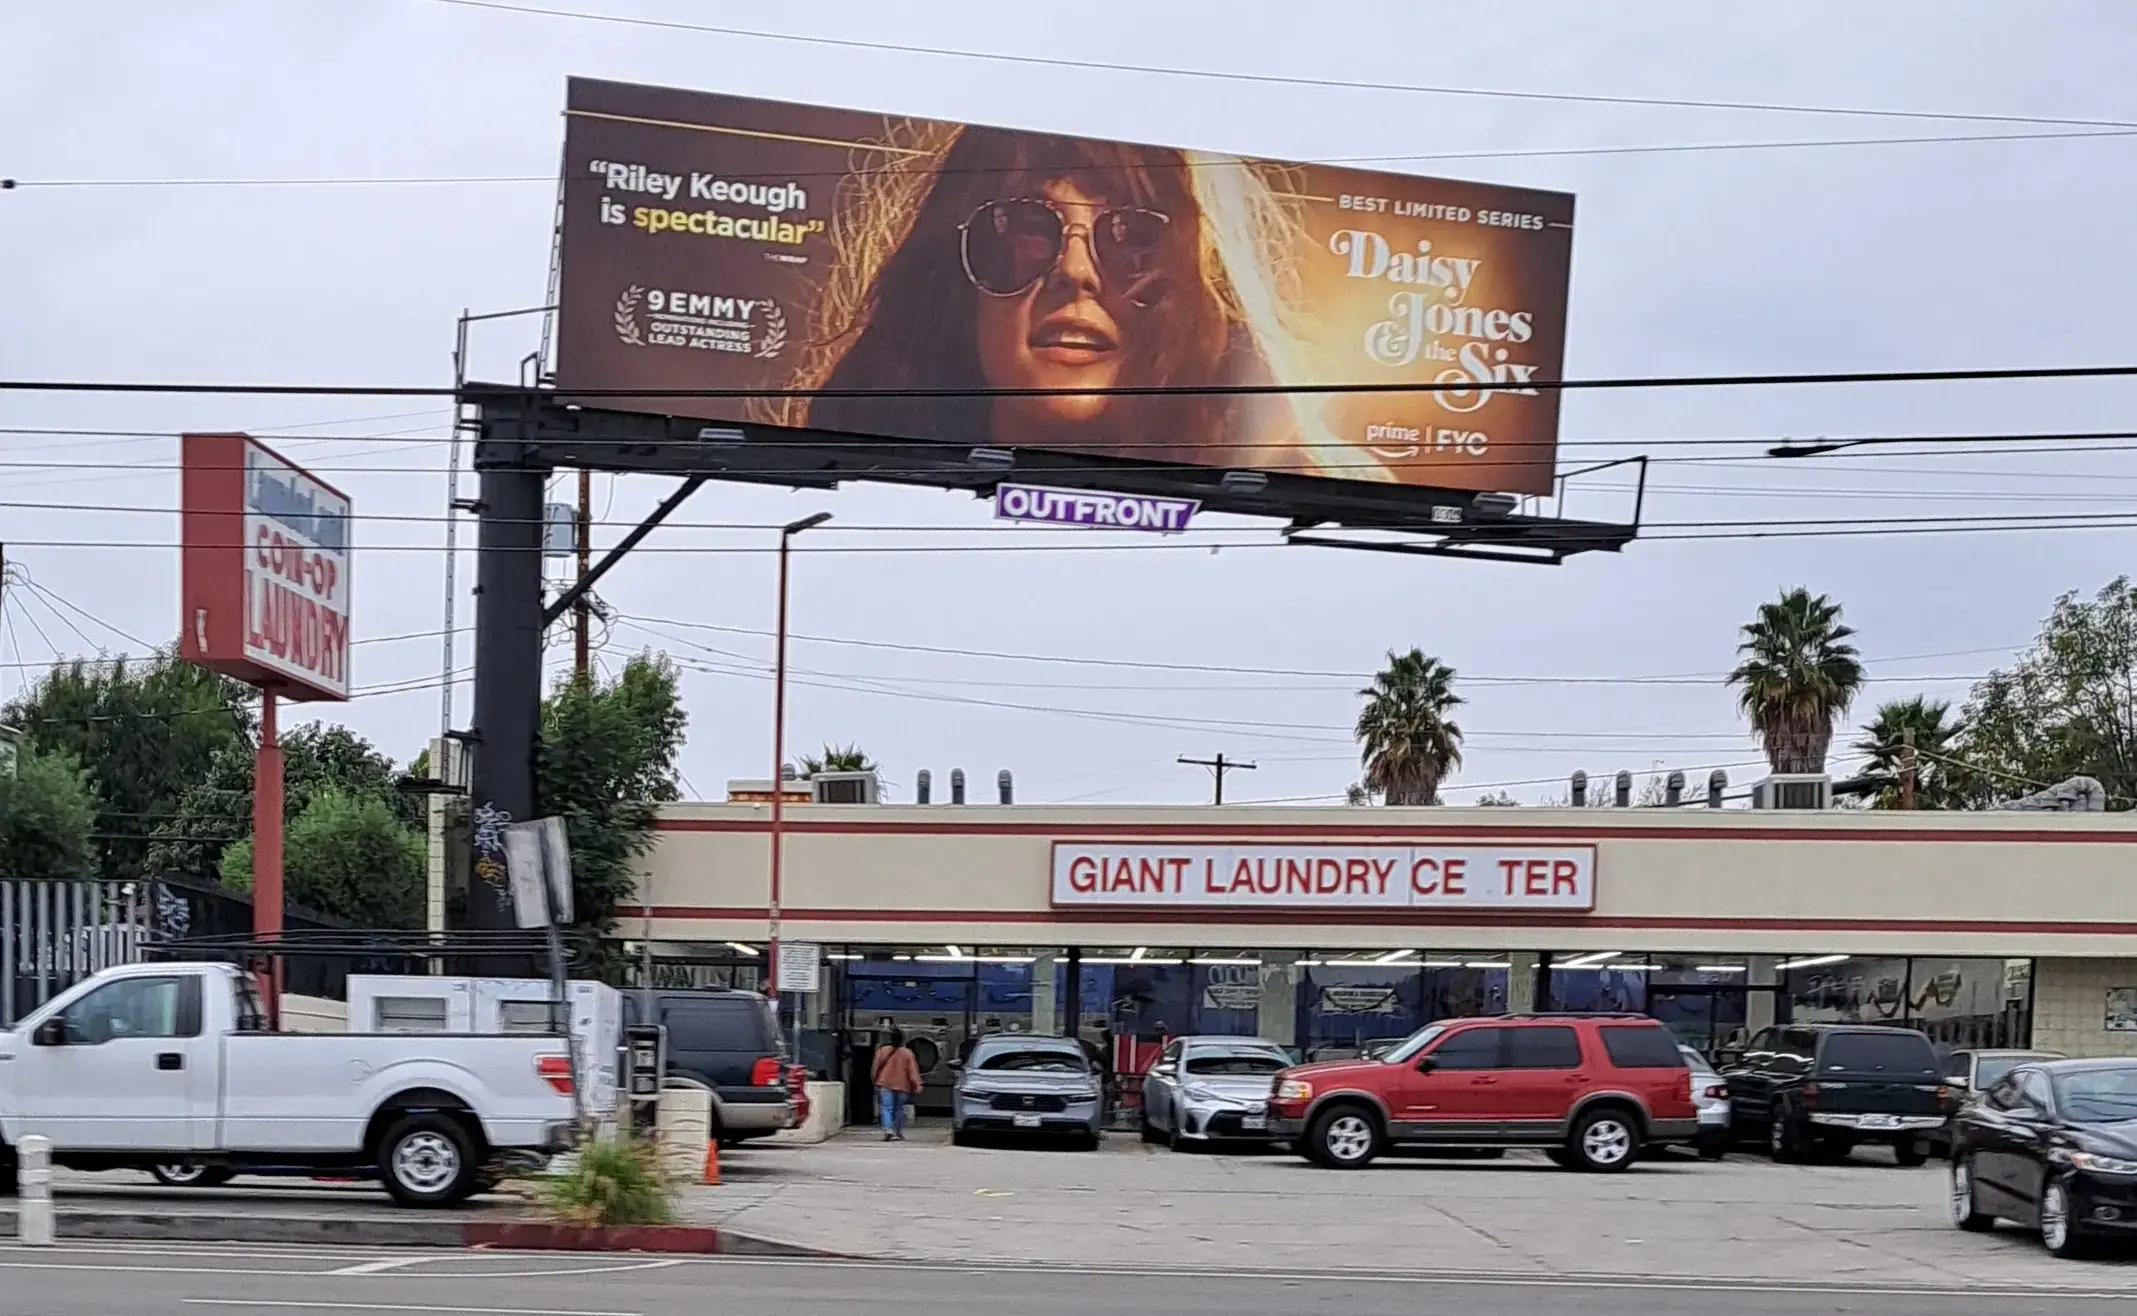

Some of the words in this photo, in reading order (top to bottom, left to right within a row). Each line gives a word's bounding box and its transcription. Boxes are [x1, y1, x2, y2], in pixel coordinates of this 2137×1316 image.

[589, 159, 682, 200] “Riley
[690, 173, 806, 212] Keough
[601, 197, 626, 225] is
[633, 206, 825, 245] spectacular”
[1339, 194, 1389, 213] BEST
[1394, 200, 1471, 223] LIMITED
[1477, 210, 1544, 230] SERIES
[1329, 229, 1482, 306] Daisy
[647, 290, 665, 311] 9
[669, 292, 755, 320] EMMY
[648, 333, 687, 346] LEAD
[689, 337, 751, 353] ACTRESS
[650, 322, 750, 341] OUTSTANDING
[1365, 320, 1414, 366] &
[1388, 291, 1533, 364] Jones
[1424, 340, 1457, 362] the
[1432, 341, 1541, 413] Six
[1366, 422, 1420, 442] prime
[1436, 429, 1489, 455] FYC
[1003, 488, 1189, 529] OUTFRONT
[244, 569, 348, 682] LAUNDRY
[1069, 856, 1193, 893] GIANT
[1204, 857, 1397, 895] LAUNDRY
